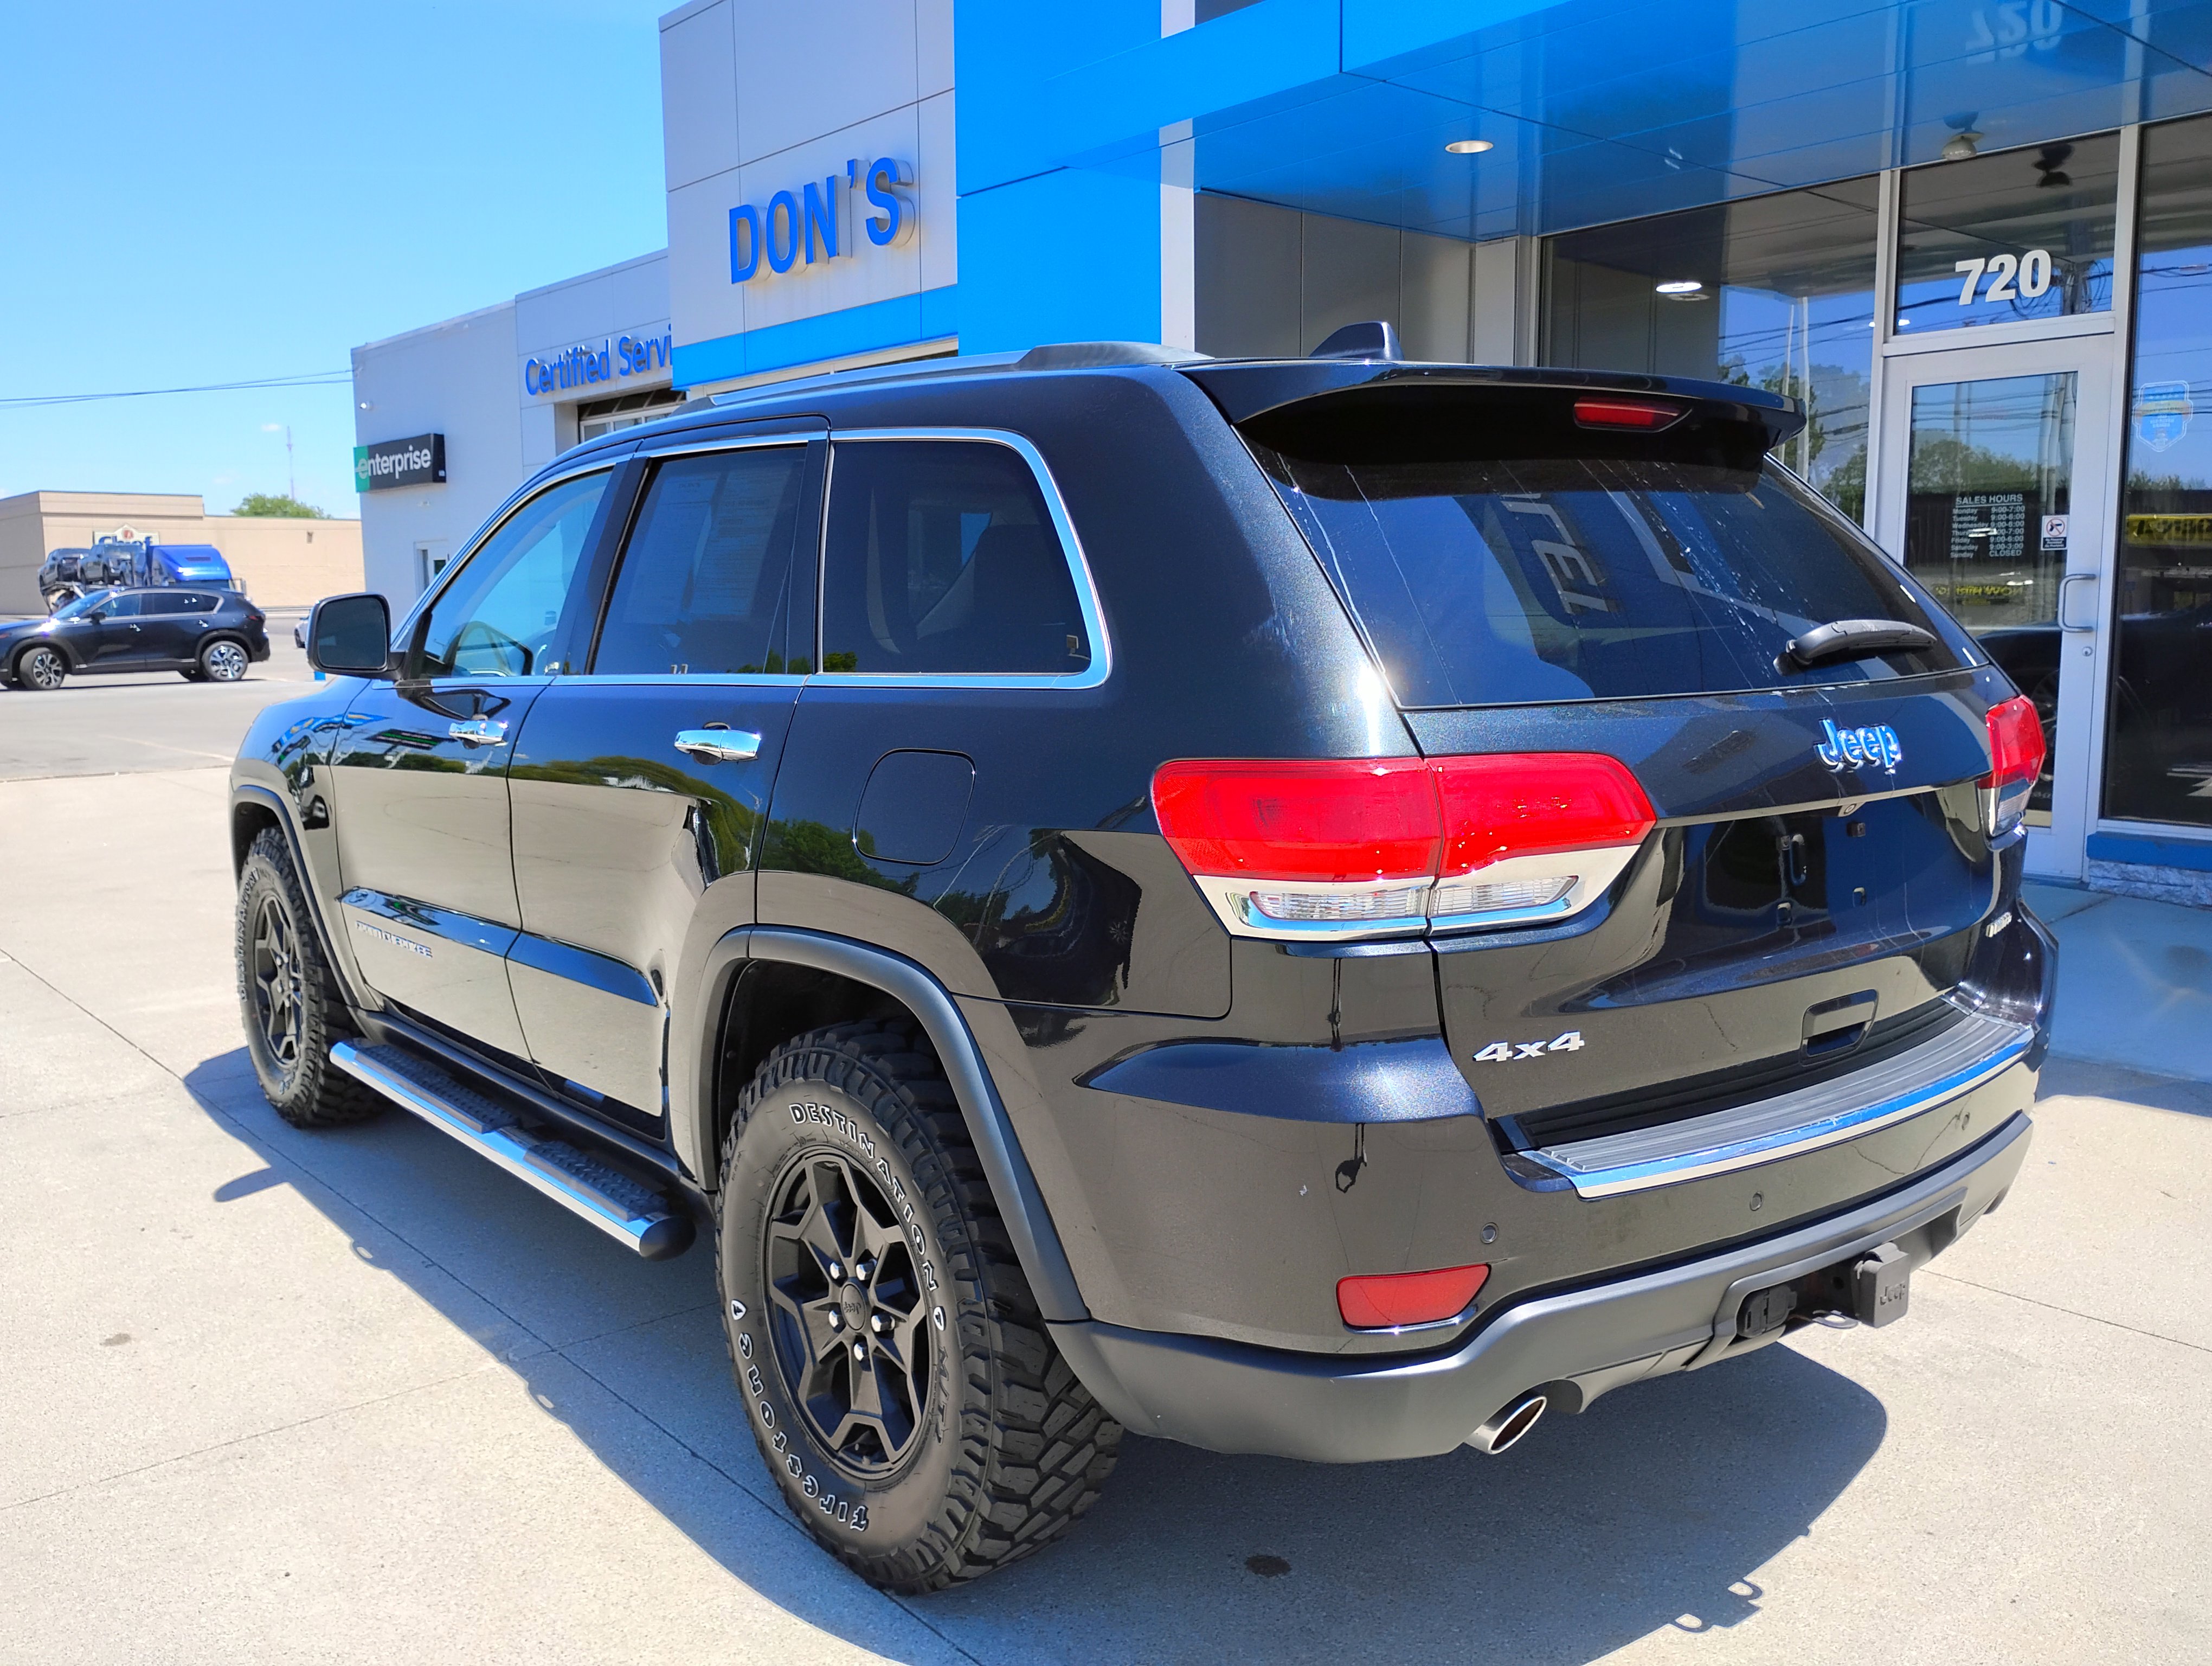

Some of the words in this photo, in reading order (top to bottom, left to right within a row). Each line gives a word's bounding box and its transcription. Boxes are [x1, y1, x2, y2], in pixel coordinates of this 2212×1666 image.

[729, 157, 909, 284] DON'S
[1955, 249, 2051, 305] 720
[525, 338, 611, 395] Certified
[355, 444, 431, 479] enterprise
[1956, 496, 1986, 505] SALES
[1989, 494, 2023, 503] HOURS
[1813, 717, 1902, 771] Jeep
[1472, 1030, 1585, 1062] 4x4
[789, 1103, 937, 1293] DESTINATION
